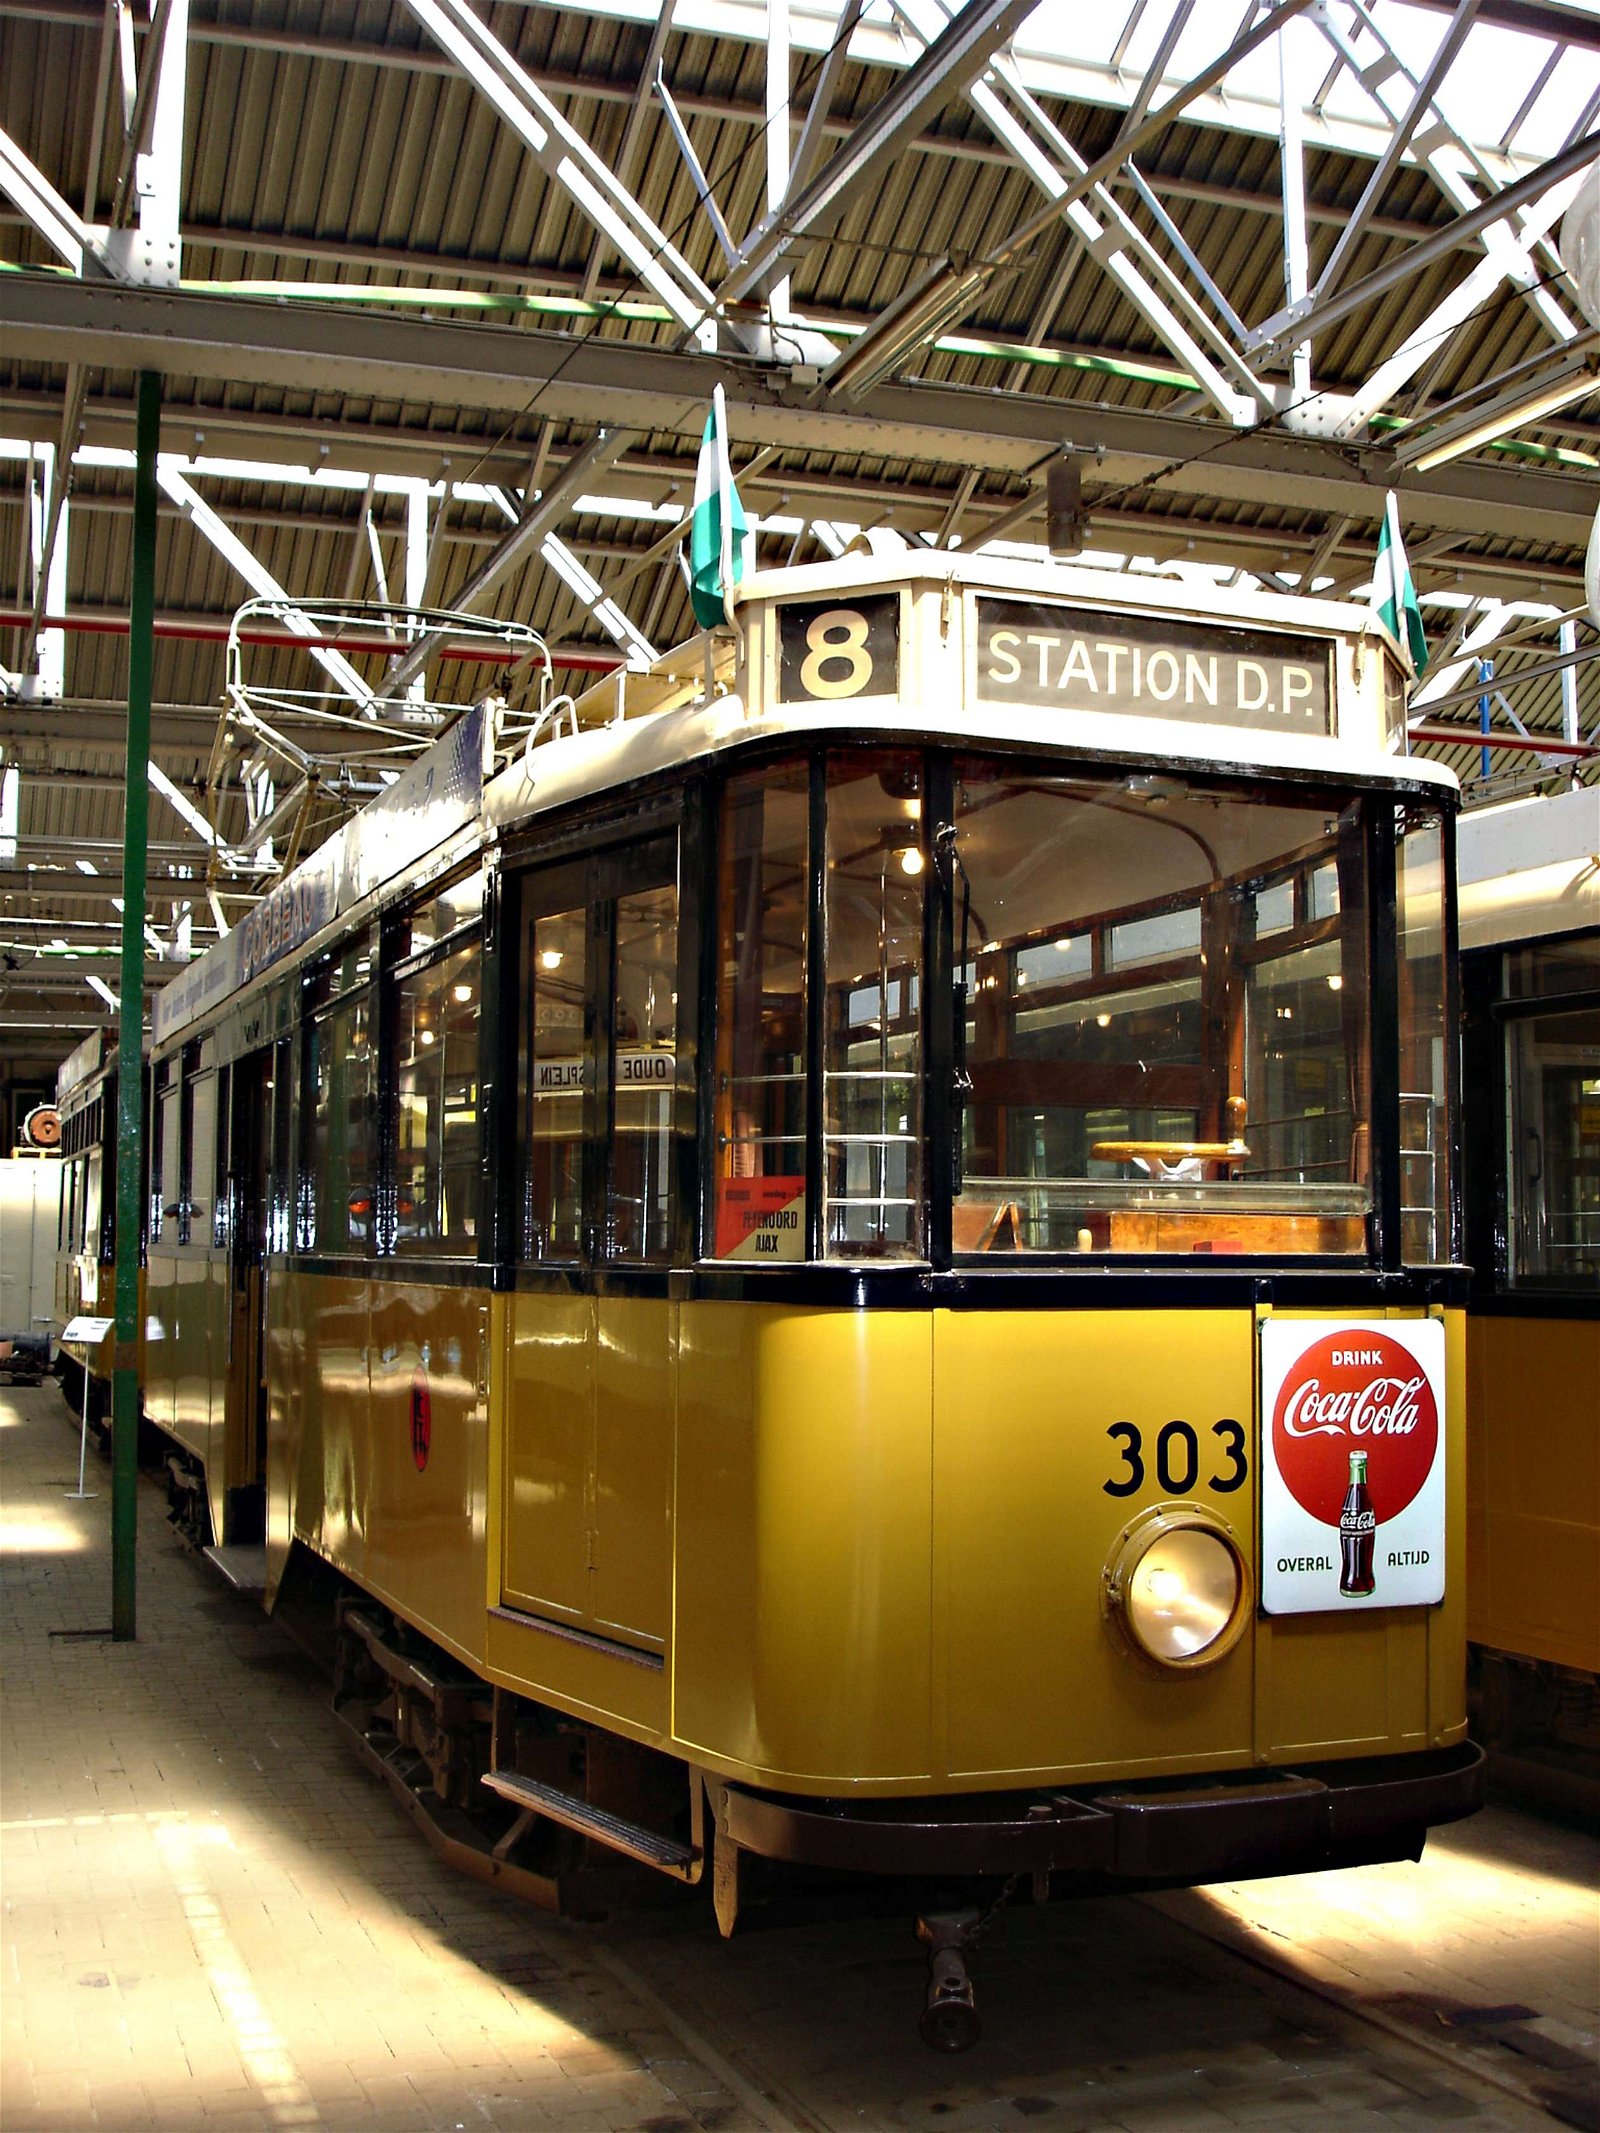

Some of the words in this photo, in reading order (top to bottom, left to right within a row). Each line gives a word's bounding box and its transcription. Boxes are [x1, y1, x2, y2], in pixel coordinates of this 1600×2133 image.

[800, 609, 873, 699] 8
[987, 631, 1218, 707] STATION
[1236, 661, 1313, 717] D.P.
[755, 1234, 779, 1253] AJAX
[1331, 1350, 1384, 1367] DRINK
[1102, 1419, 1248, 1498] 303
[1276, 1555, 1333, 1573] OVERAL
[1387, 1550, 1430, 1567] ALTIJD
